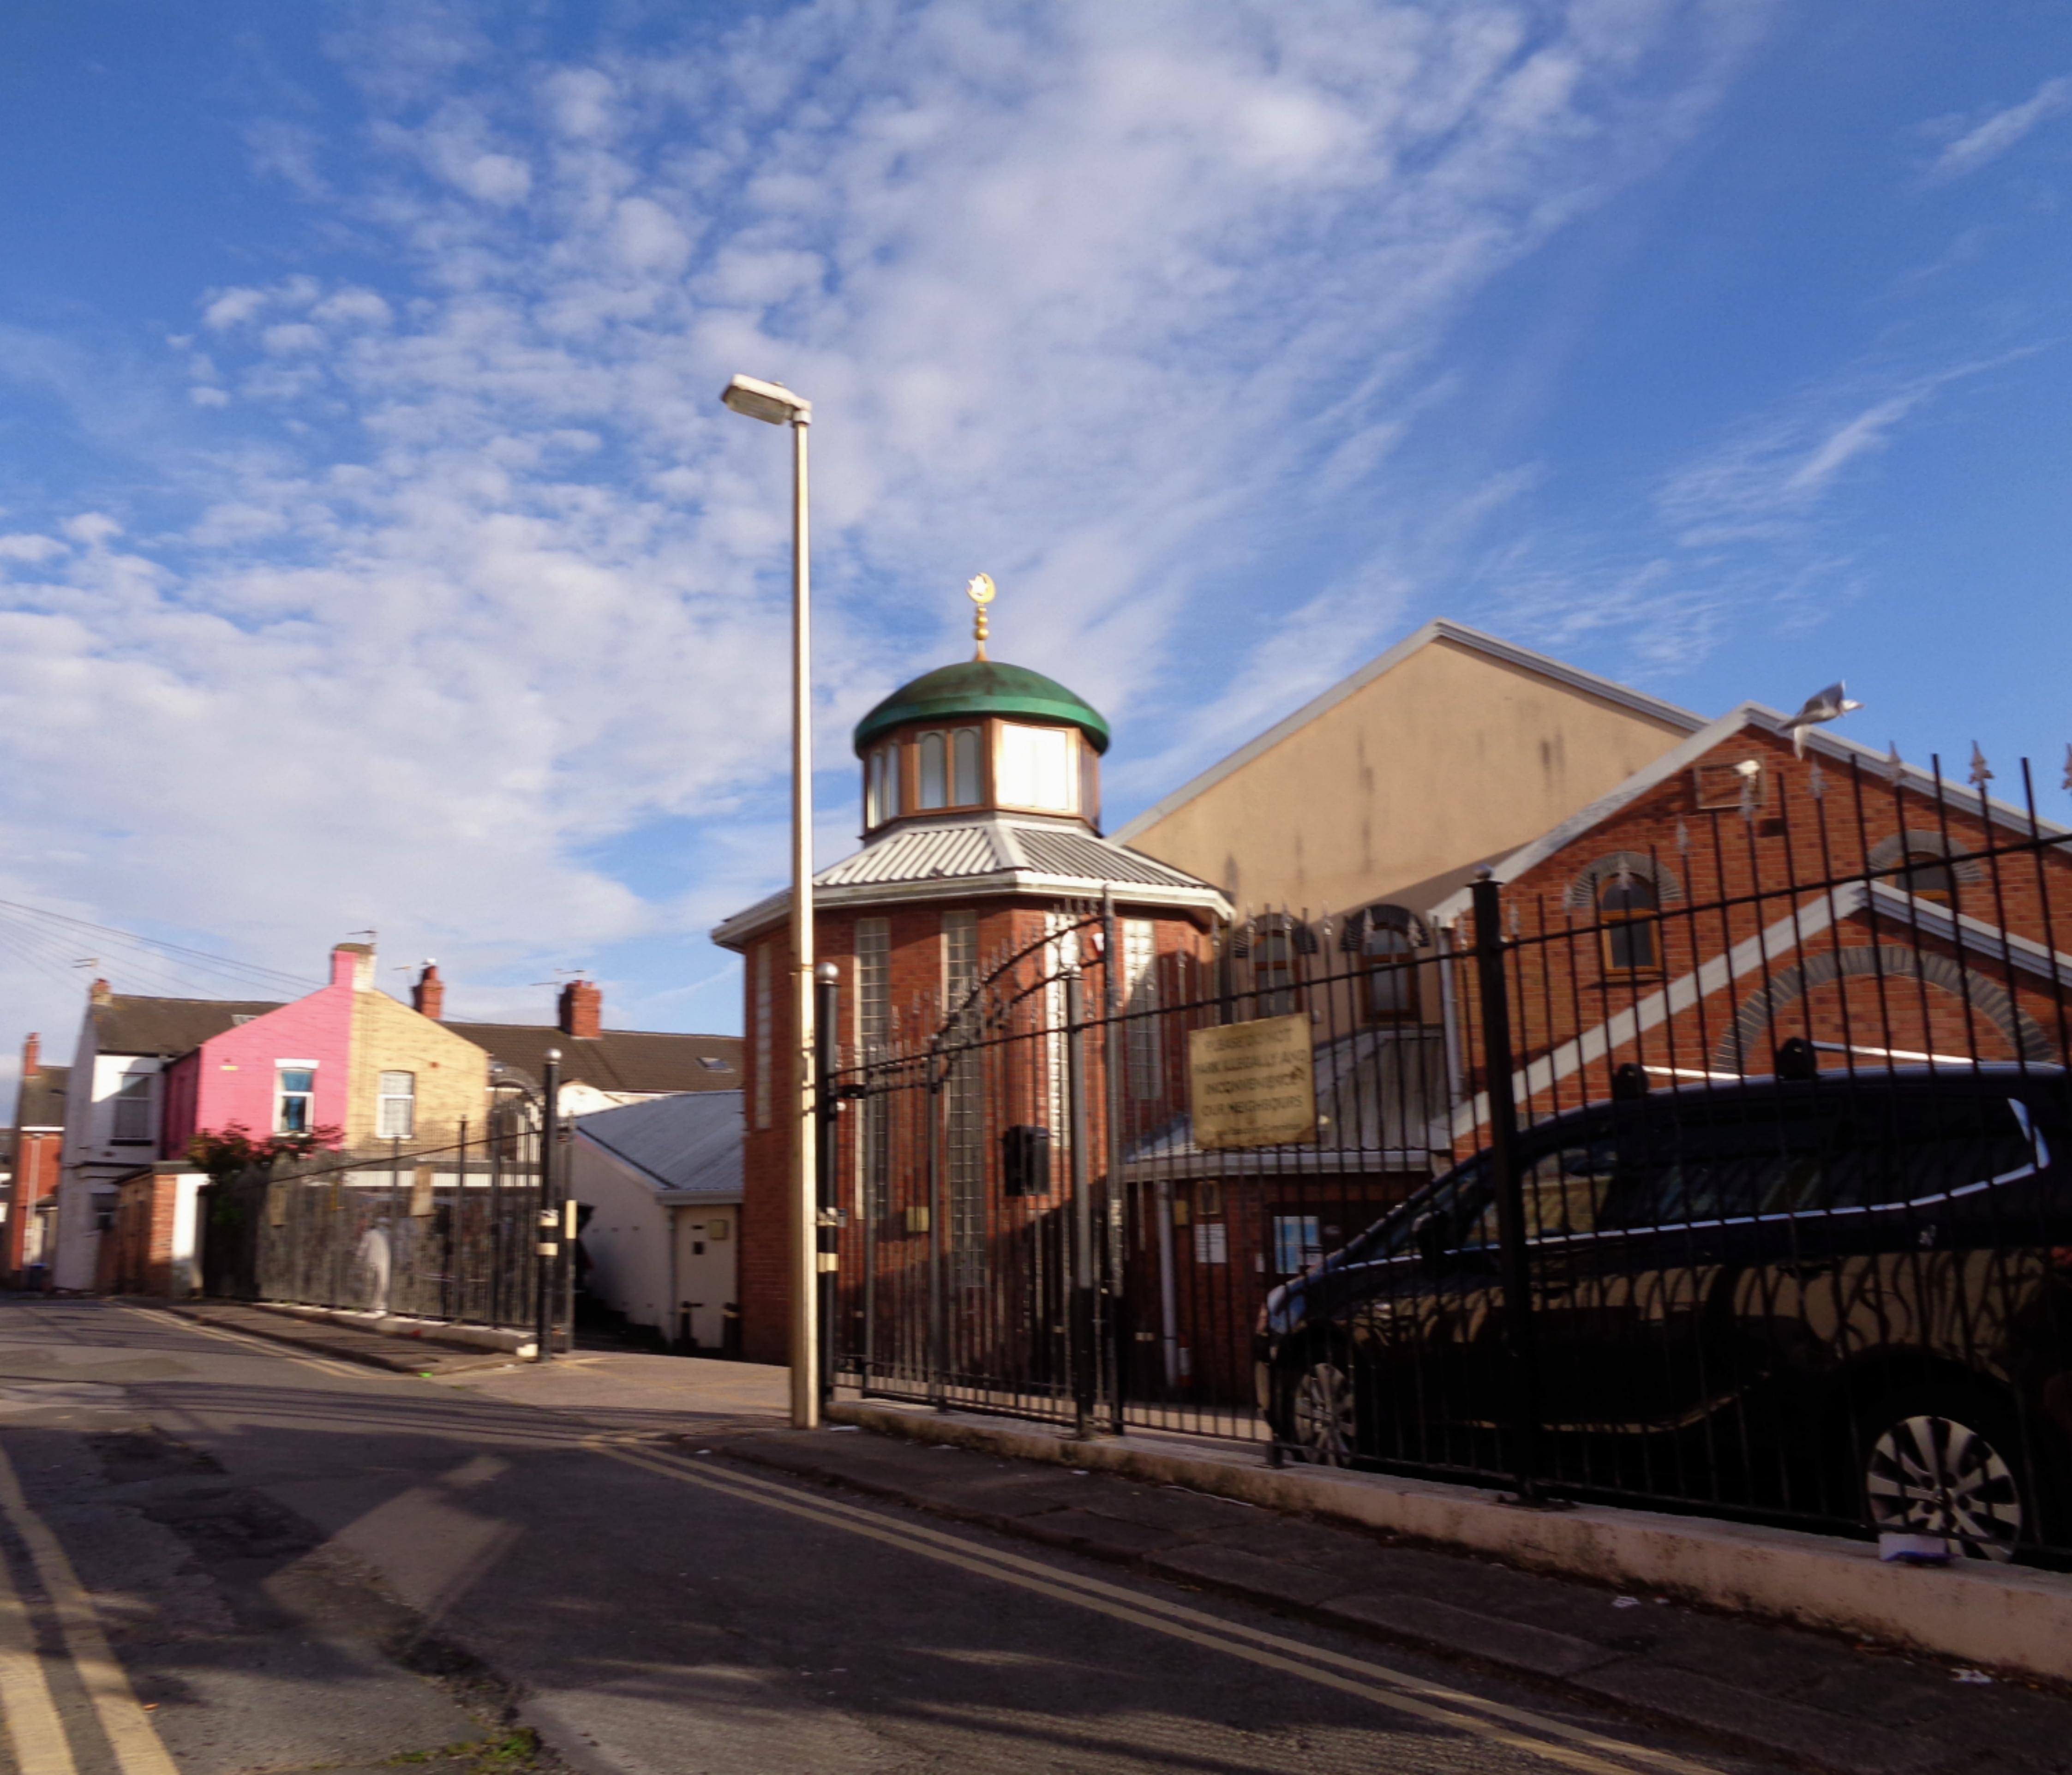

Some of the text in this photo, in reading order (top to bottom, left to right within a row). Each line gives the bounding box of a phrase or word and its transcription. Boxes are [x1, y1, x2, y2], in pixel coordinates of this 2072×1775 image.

[1204, 1027, 1293, 1053] PLEASE DO NOT
[1193, 1048, 1307, 1075] PARK ILLEGALLY AND
[1201, 1094, 1303, 1117] OUR NEIGHBOURS
